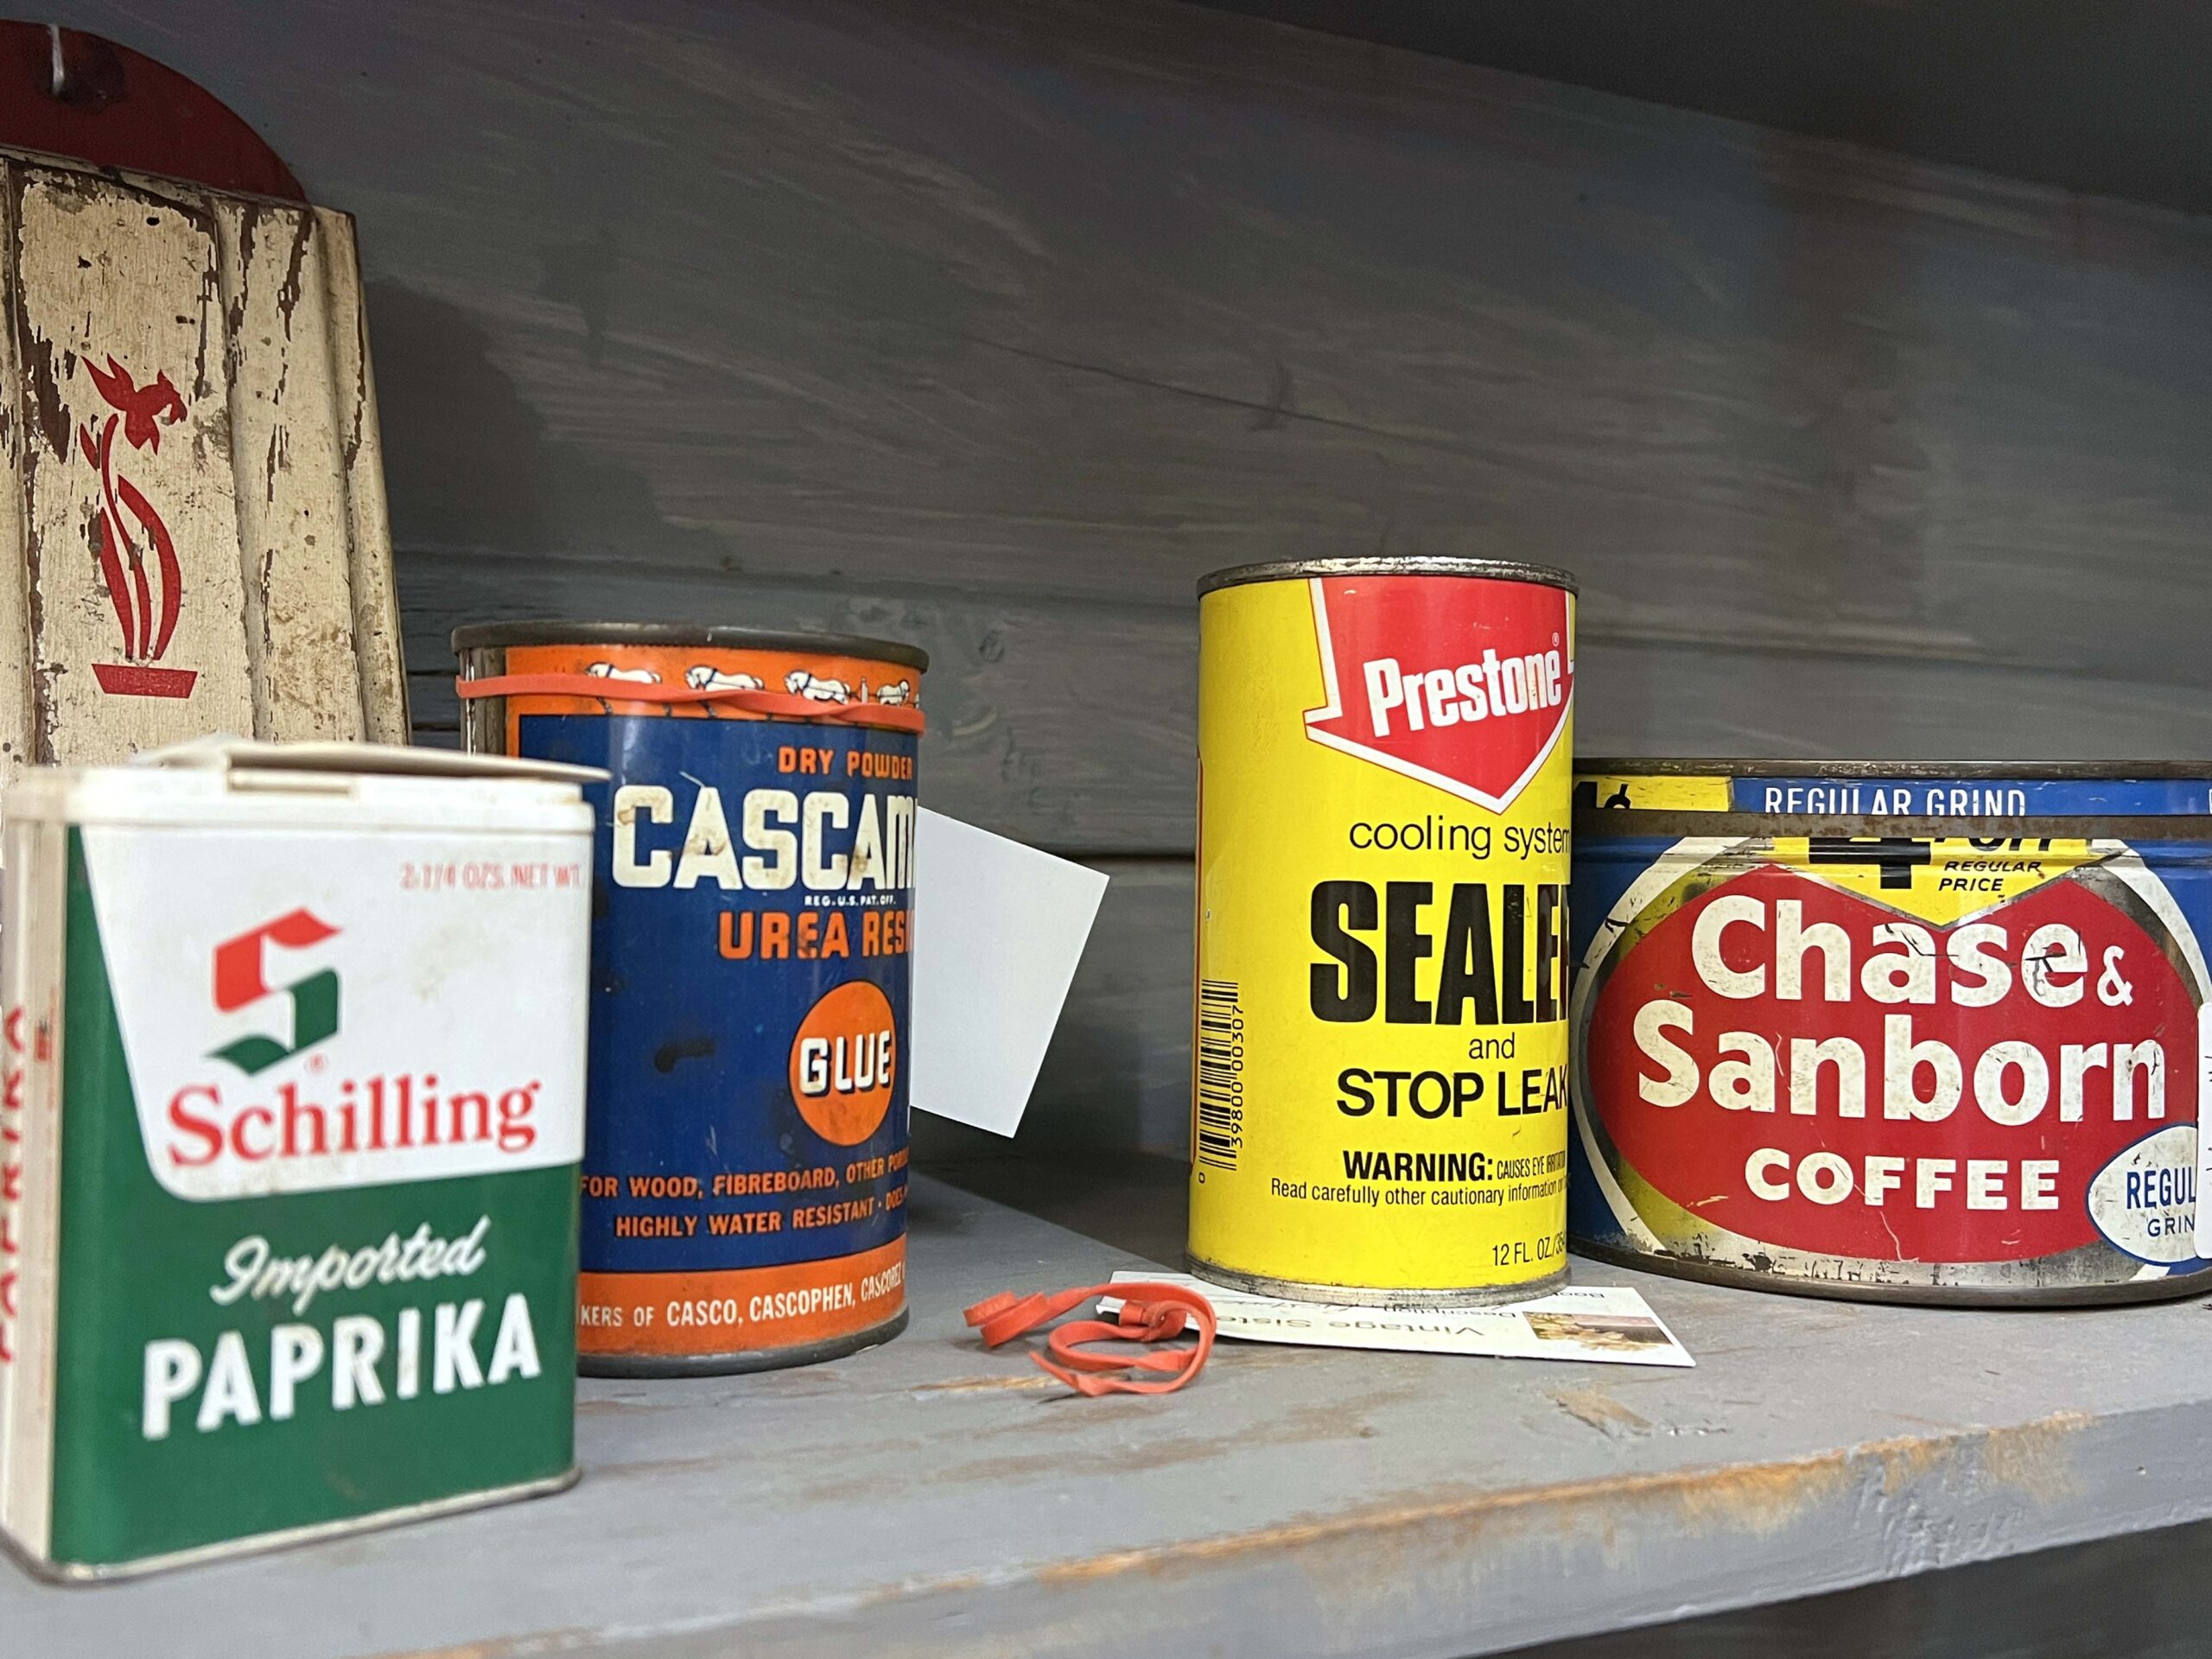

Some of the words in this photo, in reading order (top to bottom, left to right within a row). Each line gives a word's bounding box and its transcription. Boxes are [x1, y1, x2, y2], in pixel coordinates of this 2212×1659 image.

[1363, 648, 1562, 738] Prestone
[779, 746, 835, 775] DRY
[1349, 815, 1491, 860] cooling
[1503, 821, 1570, 861] system
[1938, 877, 2004, 892] PRICE
[1943, 860, 2042, 873] REGULAR
[719, 911, 850, 960] UREA
[1691, 893, 2088, 1009] Chase
[2097, 945, 2133, 1007] &
[1231, 1004, 1245, 1071] 00307
[1468, 1032, 1515, 1060] and
[799, 1029, 893, 1096] GLUE
[1632, 999, 2166, 1127] Sanborn
[1230, 1082, 1244, 1149] 39800
[1336, 1068, 1484, 1118] STOP
[167, 1074, 541, 1167] Schilling
[628, 1175, 704, 1200] WOOD,
[712, 1165, 840, 1197] FIBREBOARD,
[845, 1156, 885, 1184] OTHER
[1342, 1150, 1494, 1182] WARNING:
[1497, 1157, 1530, 1180] CAUSES
[1532, 1155, 1545, 1176] EYE
[1745, 1147, 2060, 1211] COFFEE
[2126, 1166, 2196, 1210] REGUL
[1271, 1178, 1307, 1199] Read
[1311, 1184, 1380, 1207] carefully
[1385, 1187, 1427, 1205] other
[1431, 1186, 1504, 1207] cautionary
[1508, 1179, 1557, 1202] information
[616, 1215, 698, 1237] HIGHLY
[709, 1211, 781, 1236] WATER
[791, 1197, 875, 1230] RESISTANT
[2147, 1212, 2195, 1237] GRIN
[209, 1214, 493, 1316] Imported
[1491, 1243, 1510, 1267] 12
[1514, 1241, 1534, 1264] FL.
[633, 1305, 655, 1327] OF
[666, 1300, 744, 1327] CASCO,
[749, 1281, 856, 1322] CASCOPHEN,
[1328, 1320, 1486, 1337] Vintage
[143, 1293, 542, 1441] PAPRIKA
